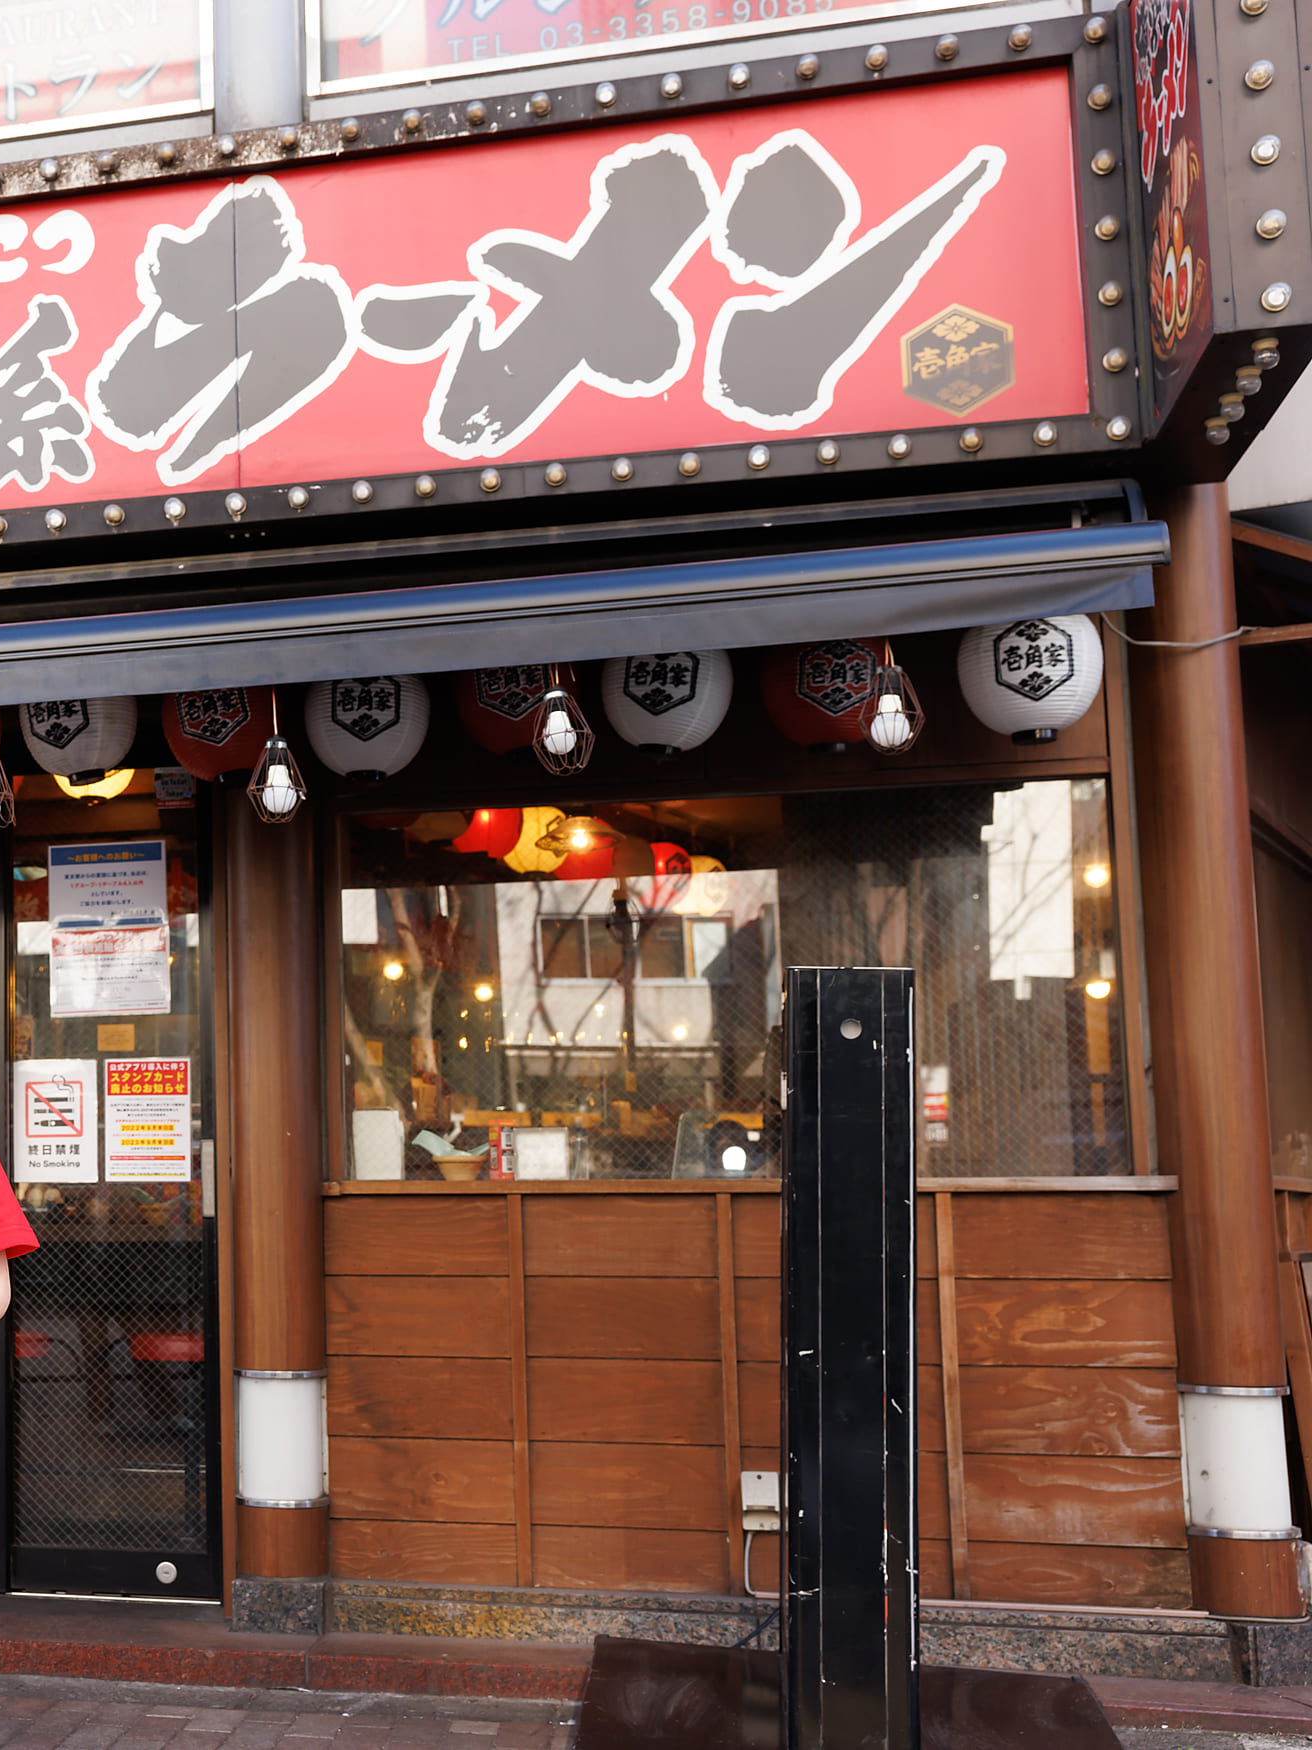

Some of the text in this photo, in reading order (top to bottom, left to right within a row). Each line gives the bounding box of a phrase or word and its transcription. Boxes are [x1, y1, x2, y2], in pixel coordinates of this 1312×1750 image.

[445, 32, 512, 63] TEL
[85, 126, 1008, 487] ラーメン
[1002, 642, 1065, 672] 壱角家
[631, 661, 690, 687] 壱角家
[807, 660, 868, 685] 壱角家
[338, 687, 393, 712] 壱角家
[110, 1083, 185, 1094] 廃止のお知らせ
[111, 1071, 184, 1082] スタンプカード
[28, 1144, 80, 1155] 終日禁煙
[29, 1160, 81, 1168] No Smoking
